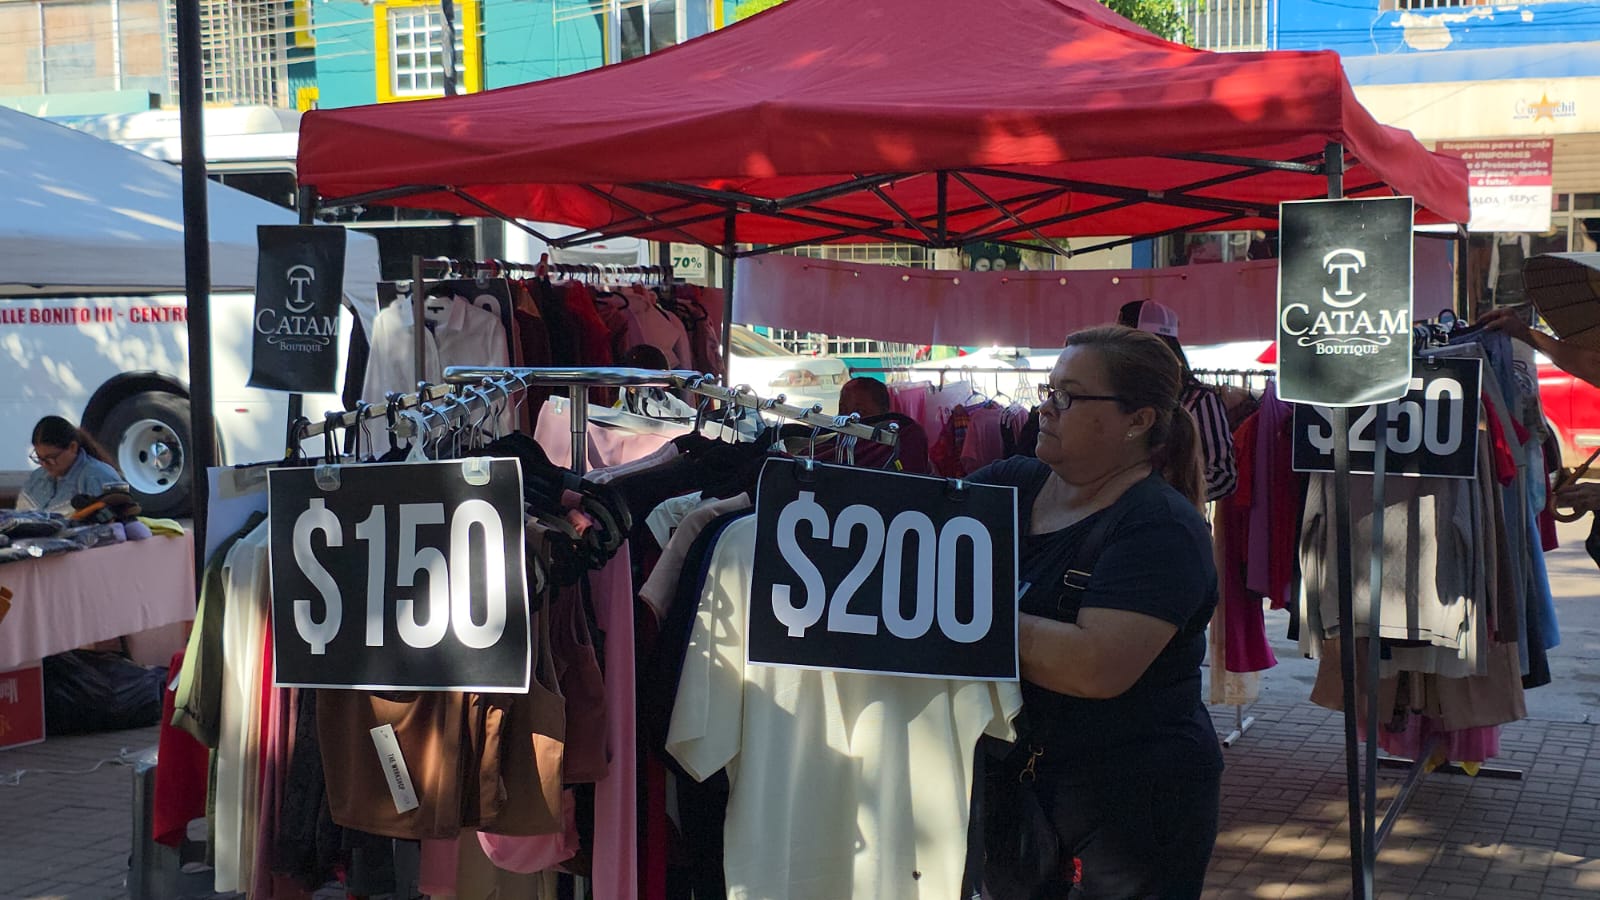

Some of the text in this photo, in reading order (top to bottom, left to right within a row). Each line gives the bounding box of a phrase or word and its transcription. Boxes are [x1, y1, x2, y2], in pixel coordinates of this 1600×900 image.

[1492, 142, 1513, 152] para
[1515, 141, 1524, 149] el
[1475, 151, 1531, 160] UNIFORMES
[1482, 160, 1548, 170] Preinscripción
[673, 256, 702, 268] 70%
[30, 307, 91, 325] BONITO
[95, 306, 113, 323] III
[255, 308, 340, 336] CATAM
[1281, 303, 1409, 336] CATAM
[280, 341, 322, 353] BOUTIQUE
[1316, 343, 1379, 356] BOUTIQUE
[771, 491, 993, 643] $200
[292, 498, 507, 655] $150
